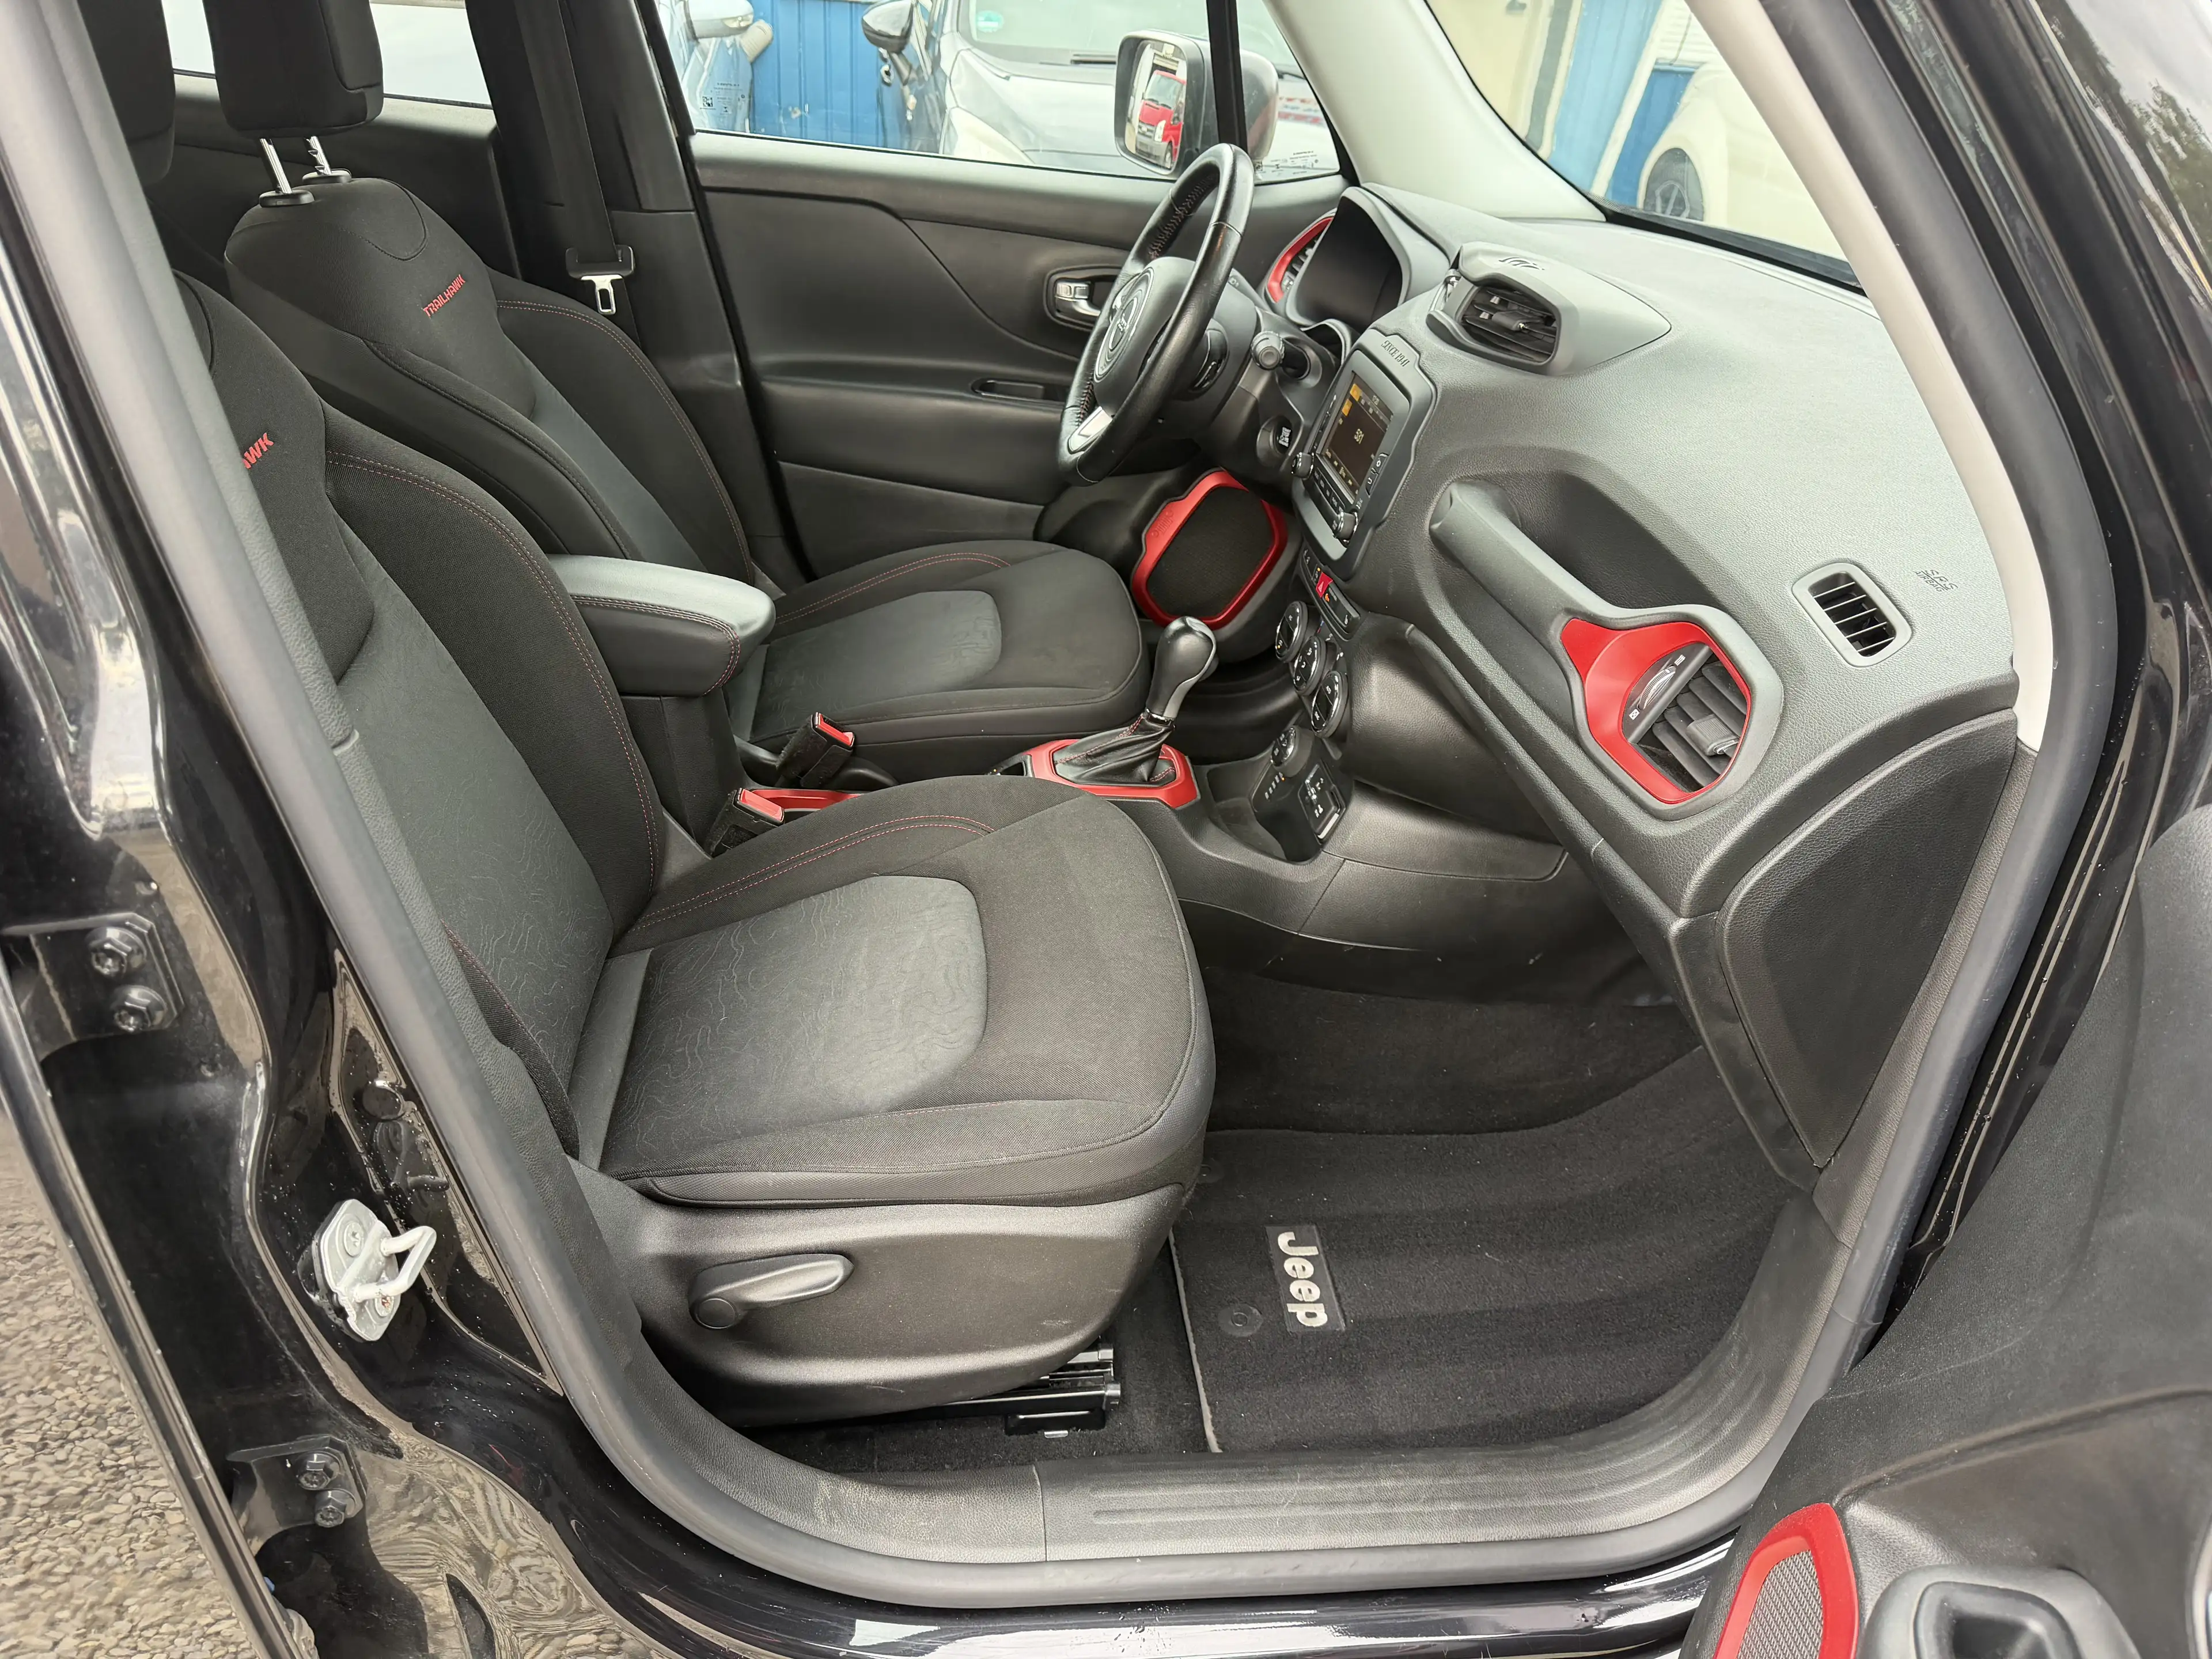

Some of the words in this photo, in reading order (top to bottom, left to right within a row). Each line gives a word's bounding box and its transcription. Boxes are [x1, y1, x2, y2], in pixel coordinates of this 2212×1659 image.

[423, 274, 466, 317] TRAILHAWK
[1381, 340, 1400, 357] SINCE
[1394, 353, 1410, 367] 1941
[1912, 571, 1945, 592] AIRBAG
[1924, 569, 1959, 590] SRS
[1277, 1231, 1328, 1327] Jeep
